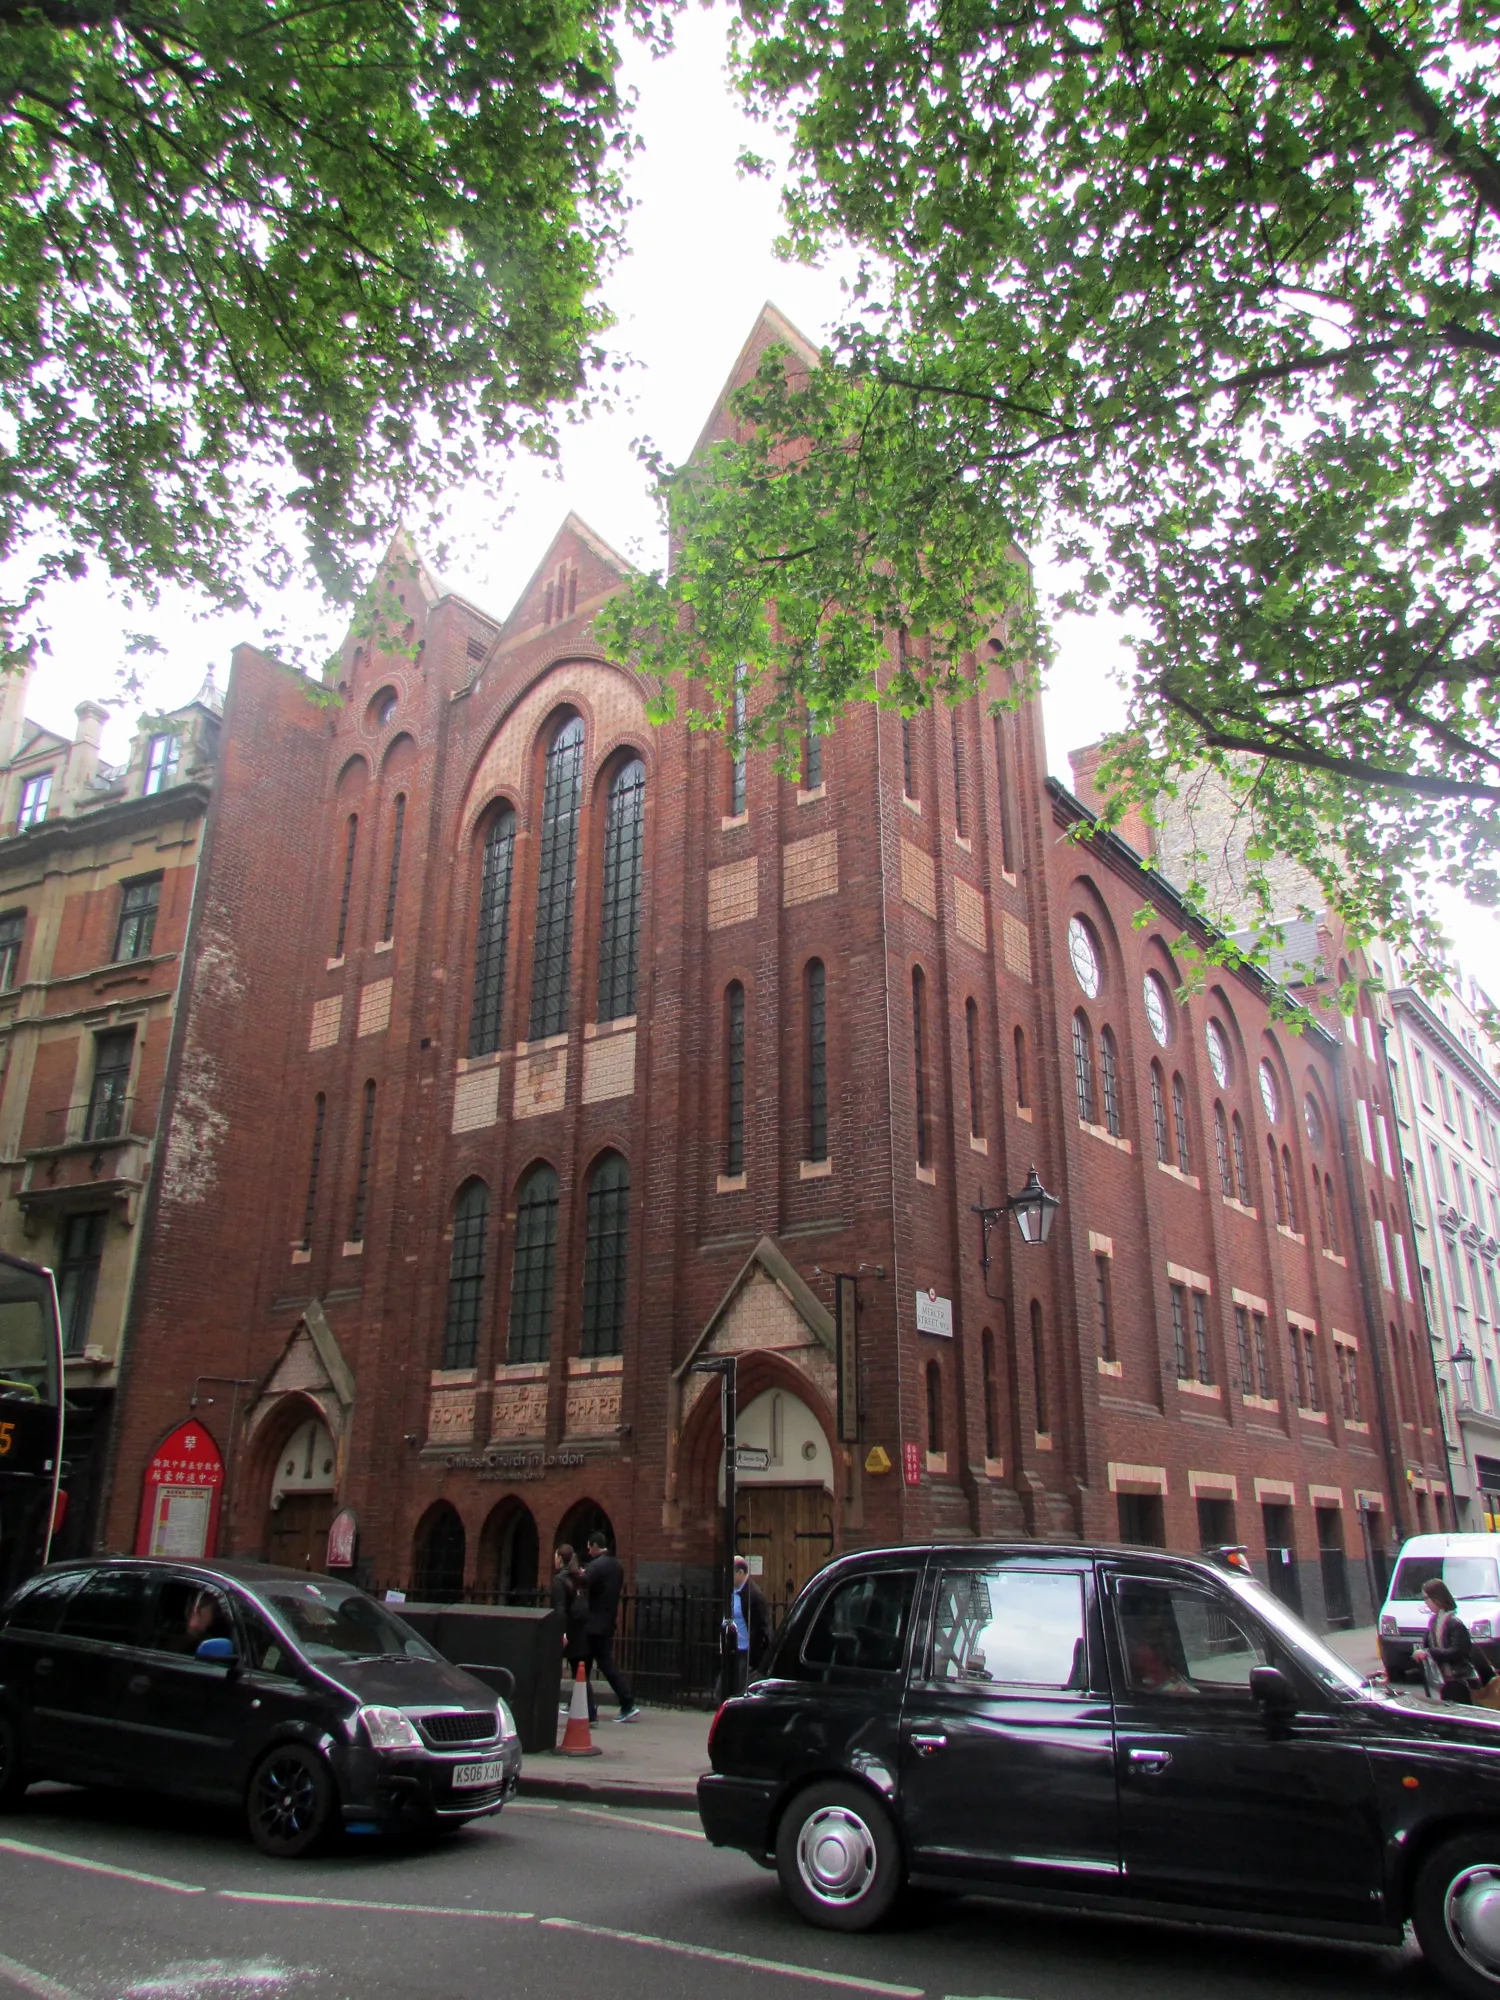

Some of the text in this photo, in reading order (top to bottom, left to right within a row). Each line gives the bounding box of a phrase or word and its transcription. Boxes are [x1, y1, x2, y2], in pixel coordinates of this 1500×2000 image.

[918, 1315, 938, 1328] STREET
[922, 1306, 945, 1320] MERCER
[432, 1406, 475, 1424] SOHO
[494, 1402, 547, 1420] BAPTIST
[446, 1449, 584, 1468] Chinese Church in London
[456, 1765, 482, 1784] KS06
